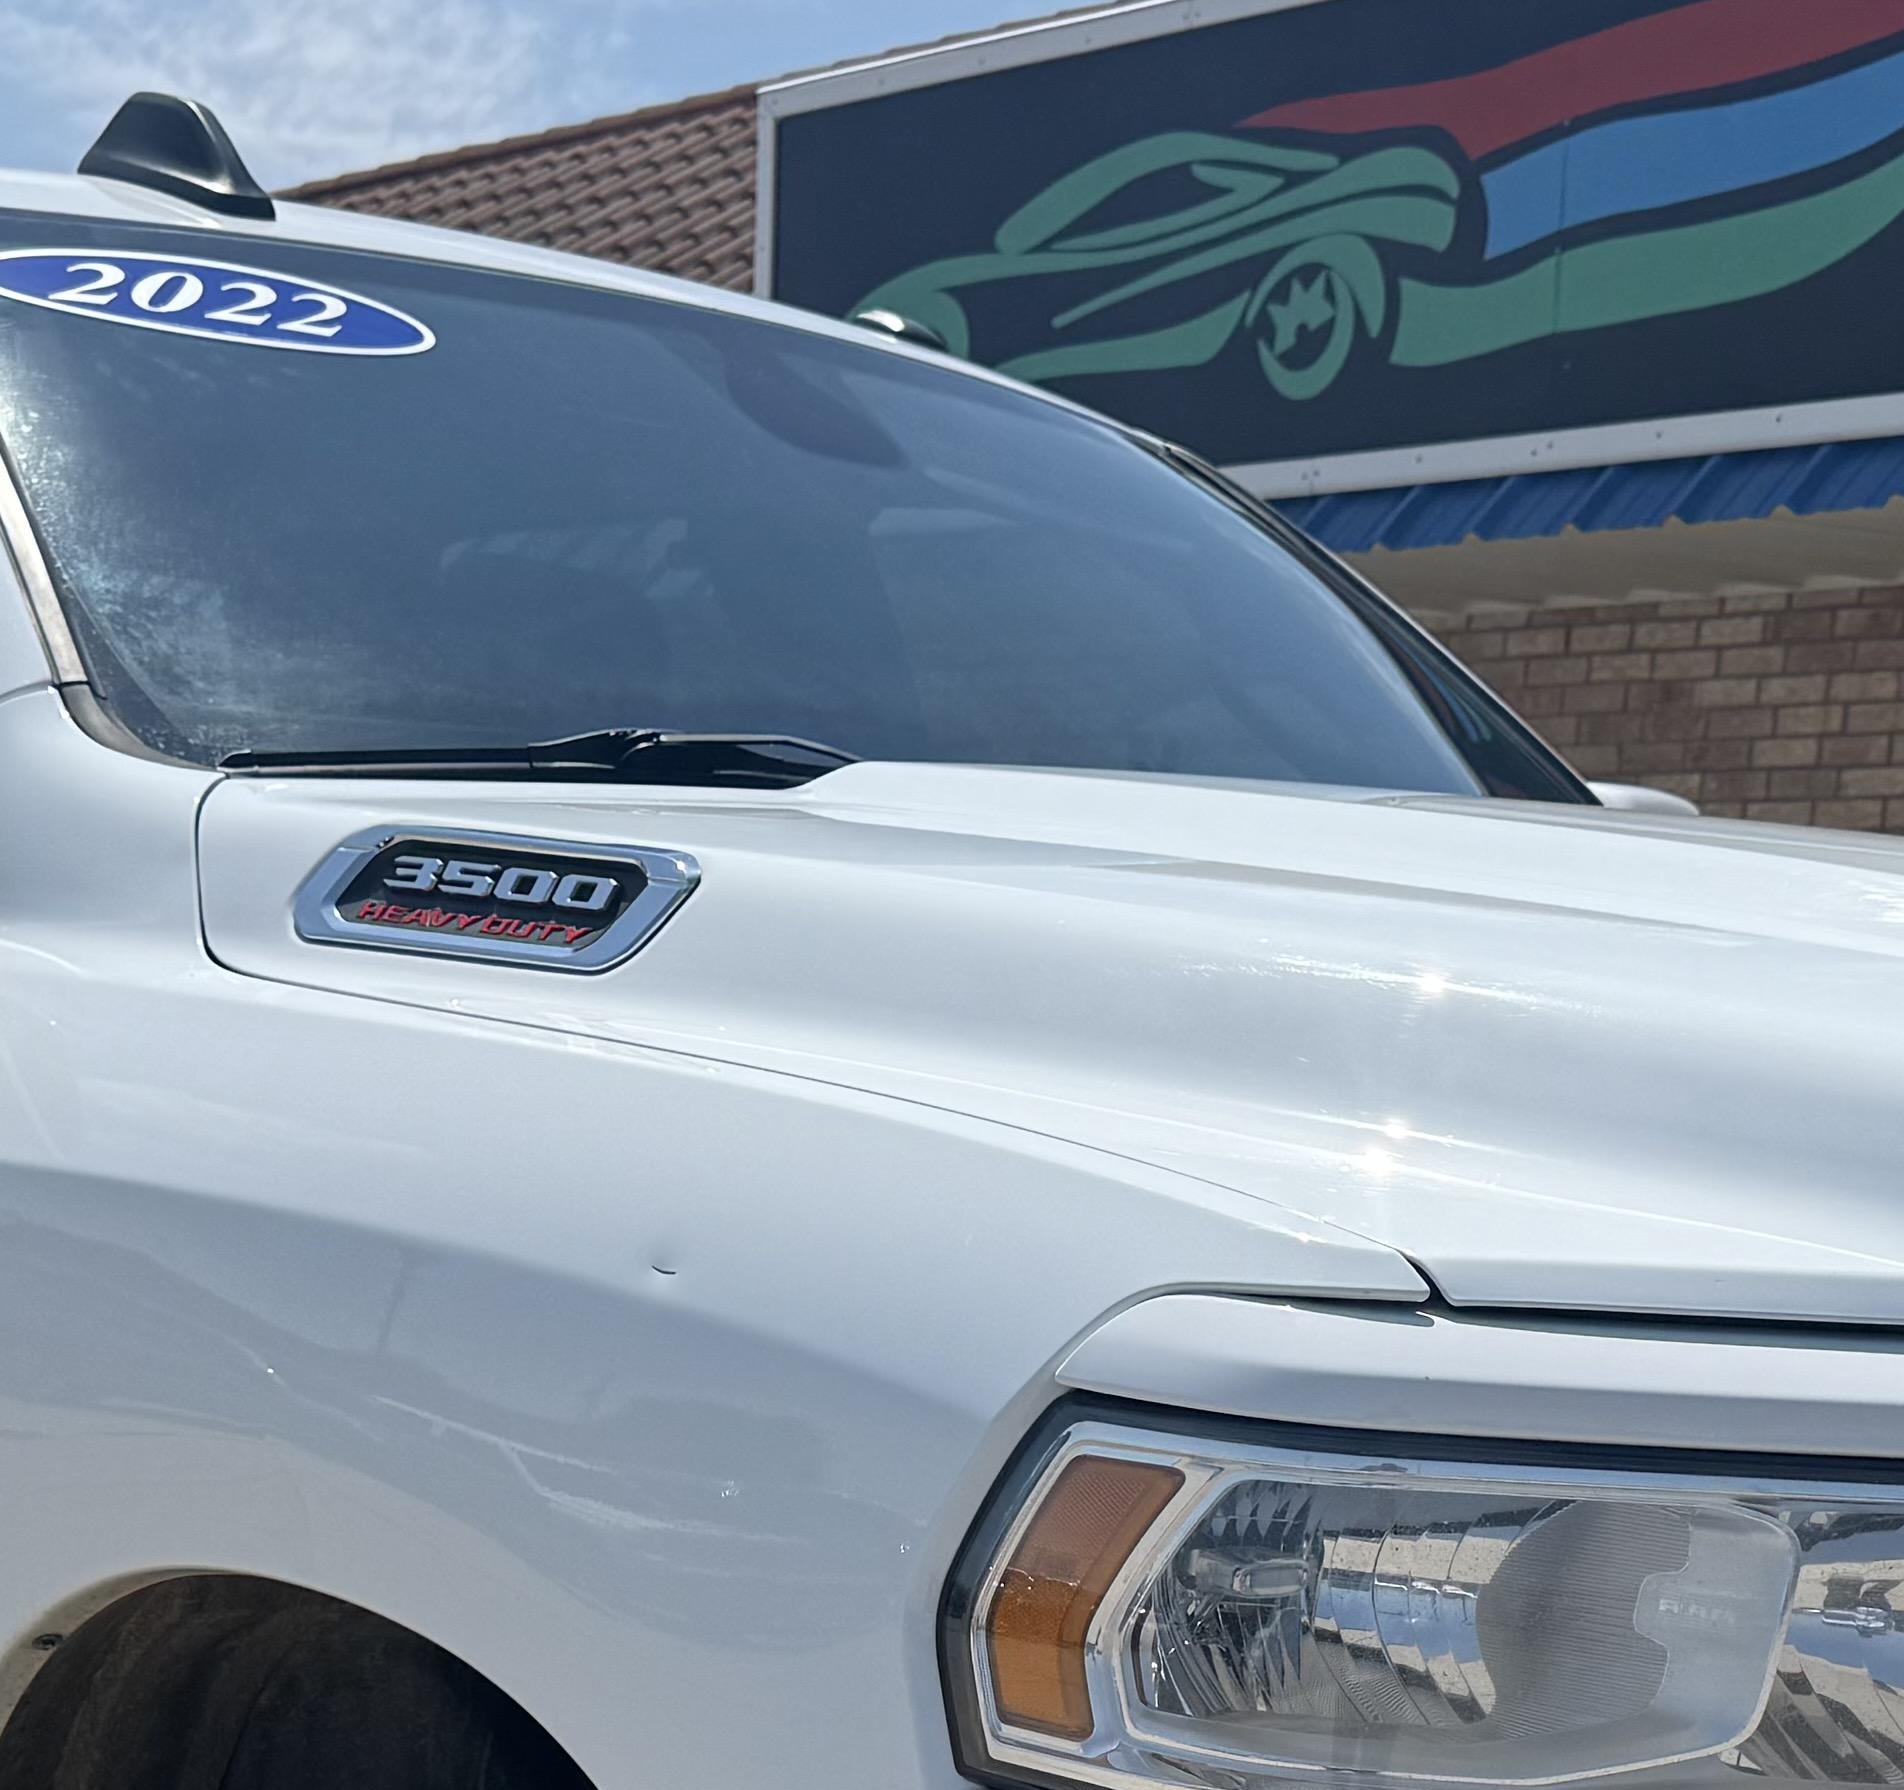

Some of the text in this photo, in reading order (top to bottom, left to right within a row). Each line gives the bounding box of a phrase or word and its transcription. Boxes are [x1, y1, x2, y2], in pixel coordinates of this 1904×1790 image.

[47, 262, 348, 337] 2022
[383, 855, 618, 910] 3500
[357, 899, 592, 944] HEAVY DUTY
